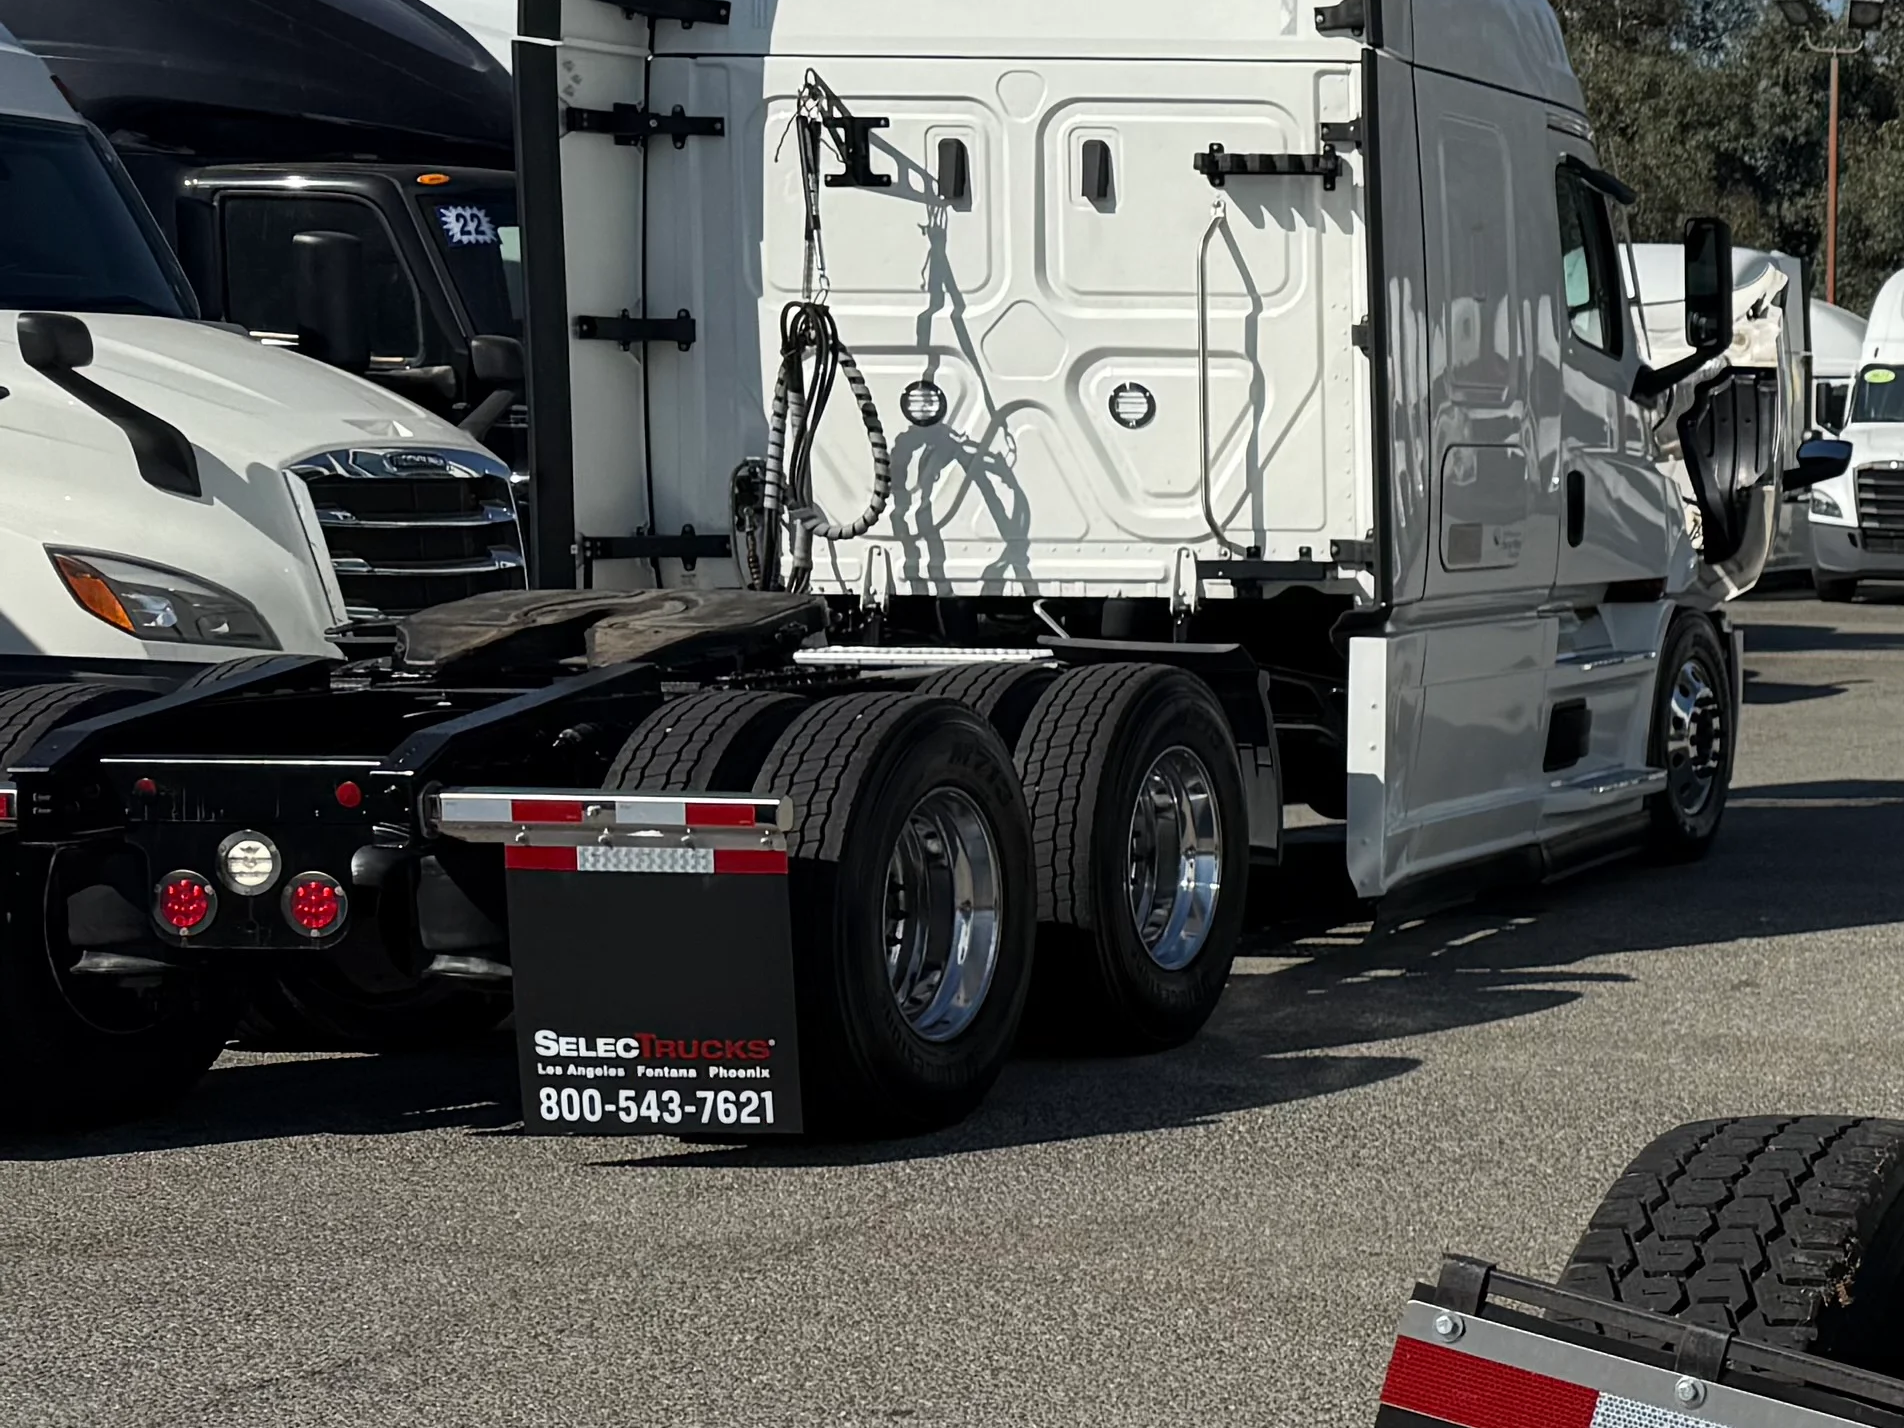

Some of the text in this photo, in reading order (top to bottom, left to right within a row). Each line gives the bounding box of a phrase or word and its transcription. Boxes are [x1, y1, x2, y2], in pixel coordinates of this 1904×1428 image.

[455, 212, 486, 236] 22
[537, 1063, 770, 1079] Los Angeles Fontana Phoenix
[538, 1086, 775, 1124] 800-543-7621
